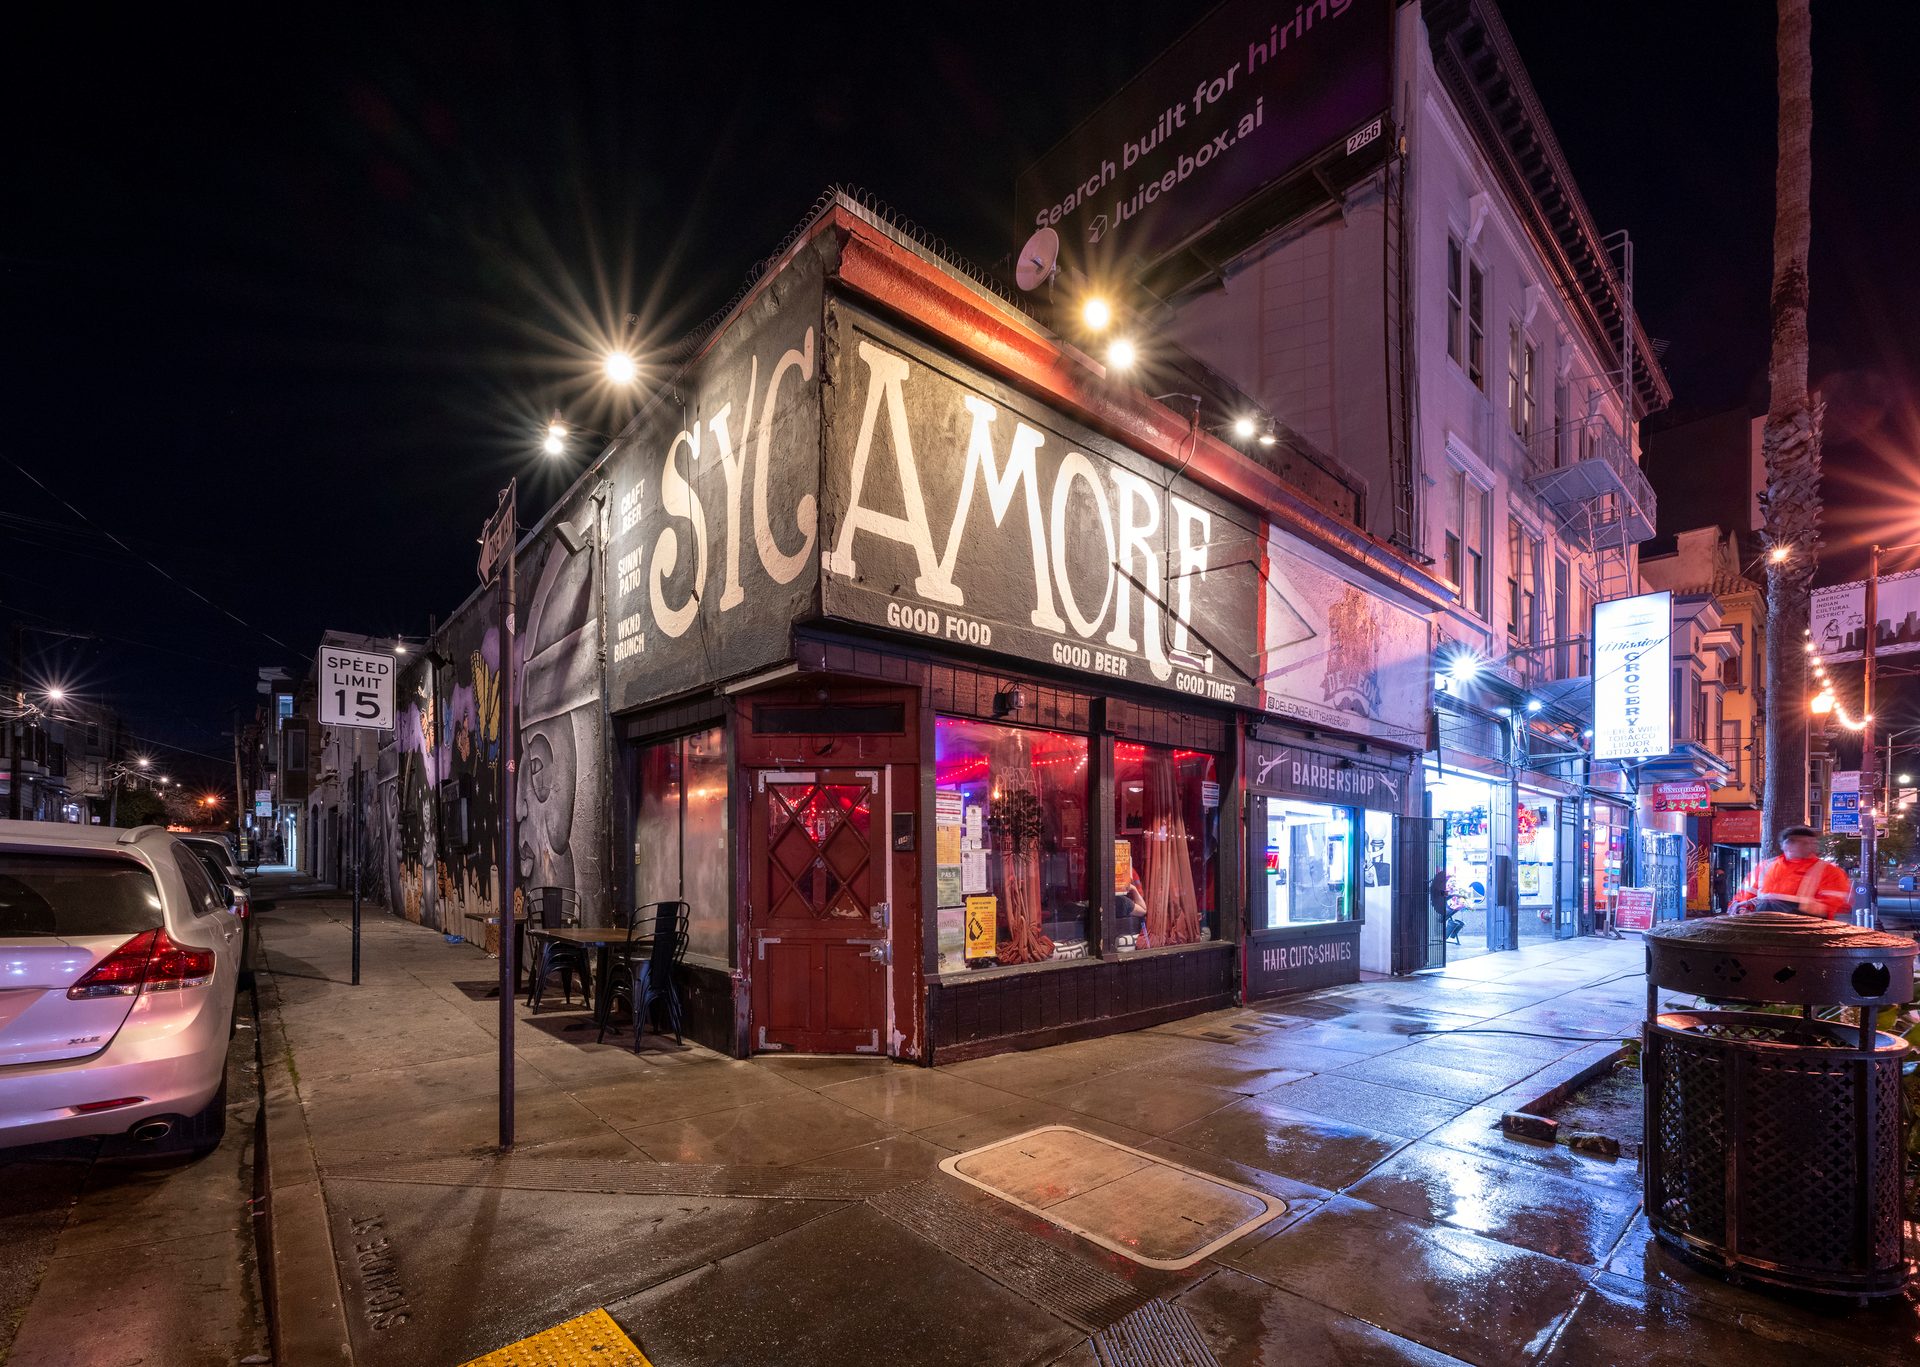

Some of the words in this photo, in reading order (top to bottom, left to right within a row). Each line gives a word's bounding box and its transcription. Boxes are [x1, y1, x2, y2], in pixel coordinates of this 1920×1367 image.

[1035, 160, 1116, 232] Search
[1123, 102, 1186, 170] built
[1193, 61, 1240, 115] for
[1349, 123, 1379, 151] 2256
[1113, 96, 1264, 229] Juicebox.ai
[621, 478, 645, 516] CRAFT
[622, 503, 642, 535] BEER
[618, 545, 643, 579] SUNNY
[619, 568, 641, 598] PATIO
[1816, 593, 1850, 603] AMERICAN
[1815, 604, 1850, 614] CULTURAL
[1815, 611, 1846, 619] DISTRICT
[1816, 601, 1839, 609] INDIAN
[618, 612, 641, 640] WKND
[887, 602, 939, 635] GOOD
[945, 615, 992, 647] FOOD
[614, 632, 645, 663] BRUNCH
[1052, 642, 1091, 669] GOOD
[1095, 651, 1128, 677] BEER
[327, 656, 389, 675] SPEED
[334, 673, 382, 689] LIMIT
[1175, 672, 1205, 694] GOOD
[1206, 680, 1236, 703] TIMES
[1624, 652, 1640, 727] GROCERY
[335, 689, 381, 719] 15
[1292, 761, 1375, 795] BARBERSHOP
[1263, 945, 1287, 972] HAIR
[68, 1036, 100, 1045] XLE
